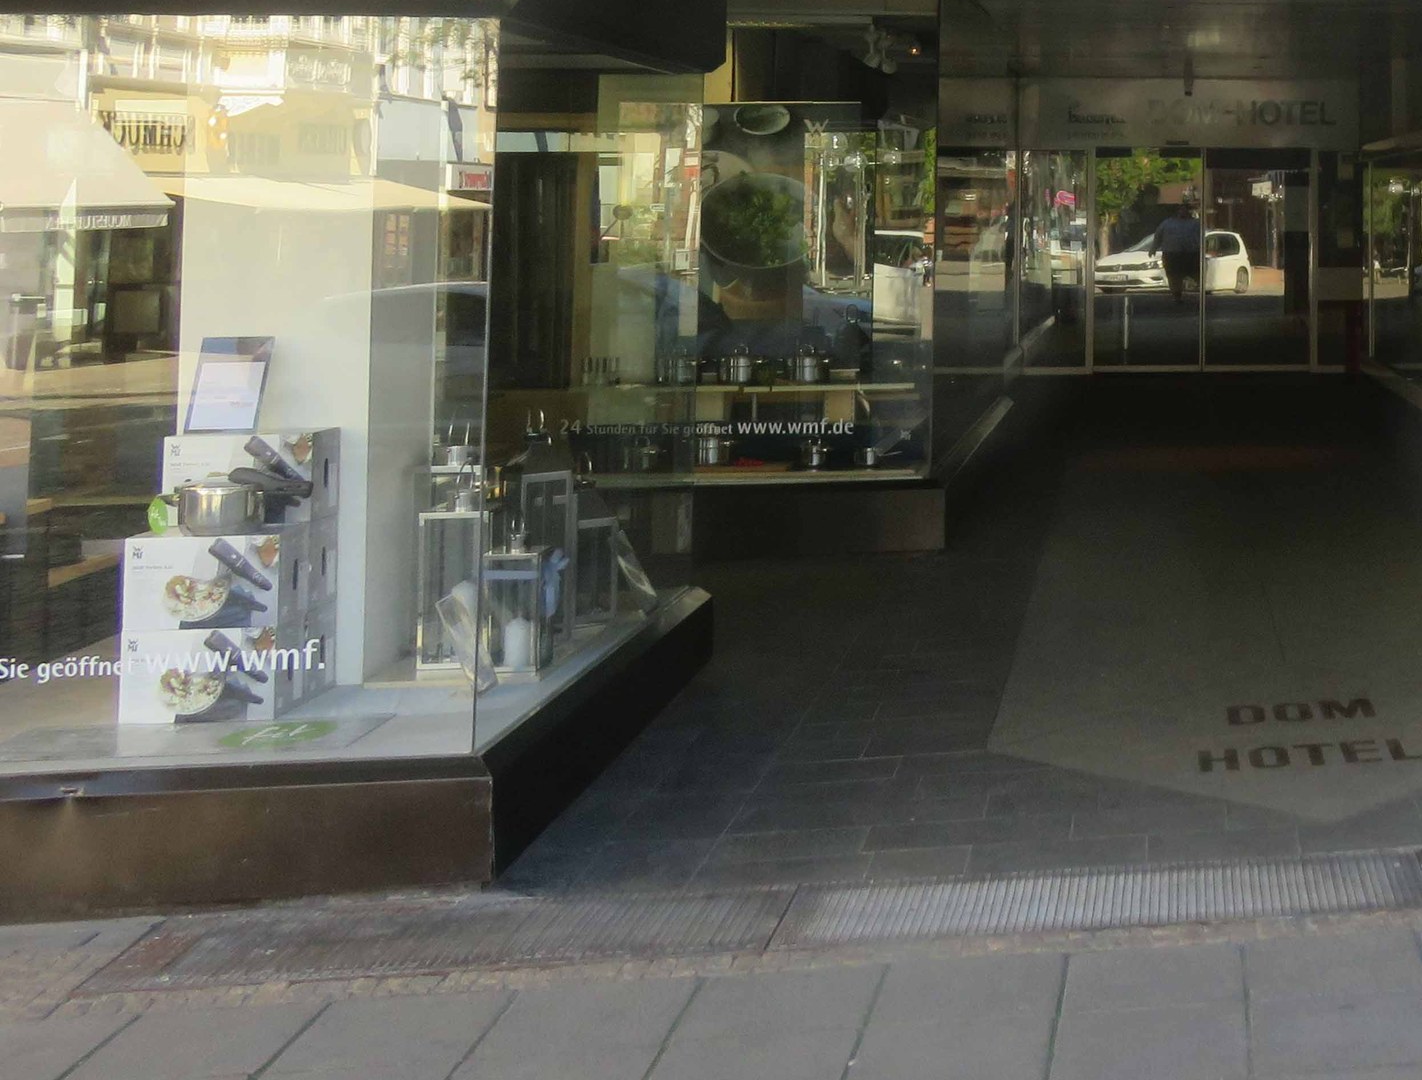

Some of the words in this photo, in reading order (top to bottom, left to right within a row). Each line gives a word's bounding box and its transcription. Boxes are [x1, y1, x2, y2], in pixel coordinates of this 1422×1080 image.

[559, 418, 582, 435] 24
[586, 422, 638, 436] Stunden
[661, 422, 681, 436] Sie
[737, 418, 855, 436] www.wmf.de
[1226, 697, 1377, 726] DOM
